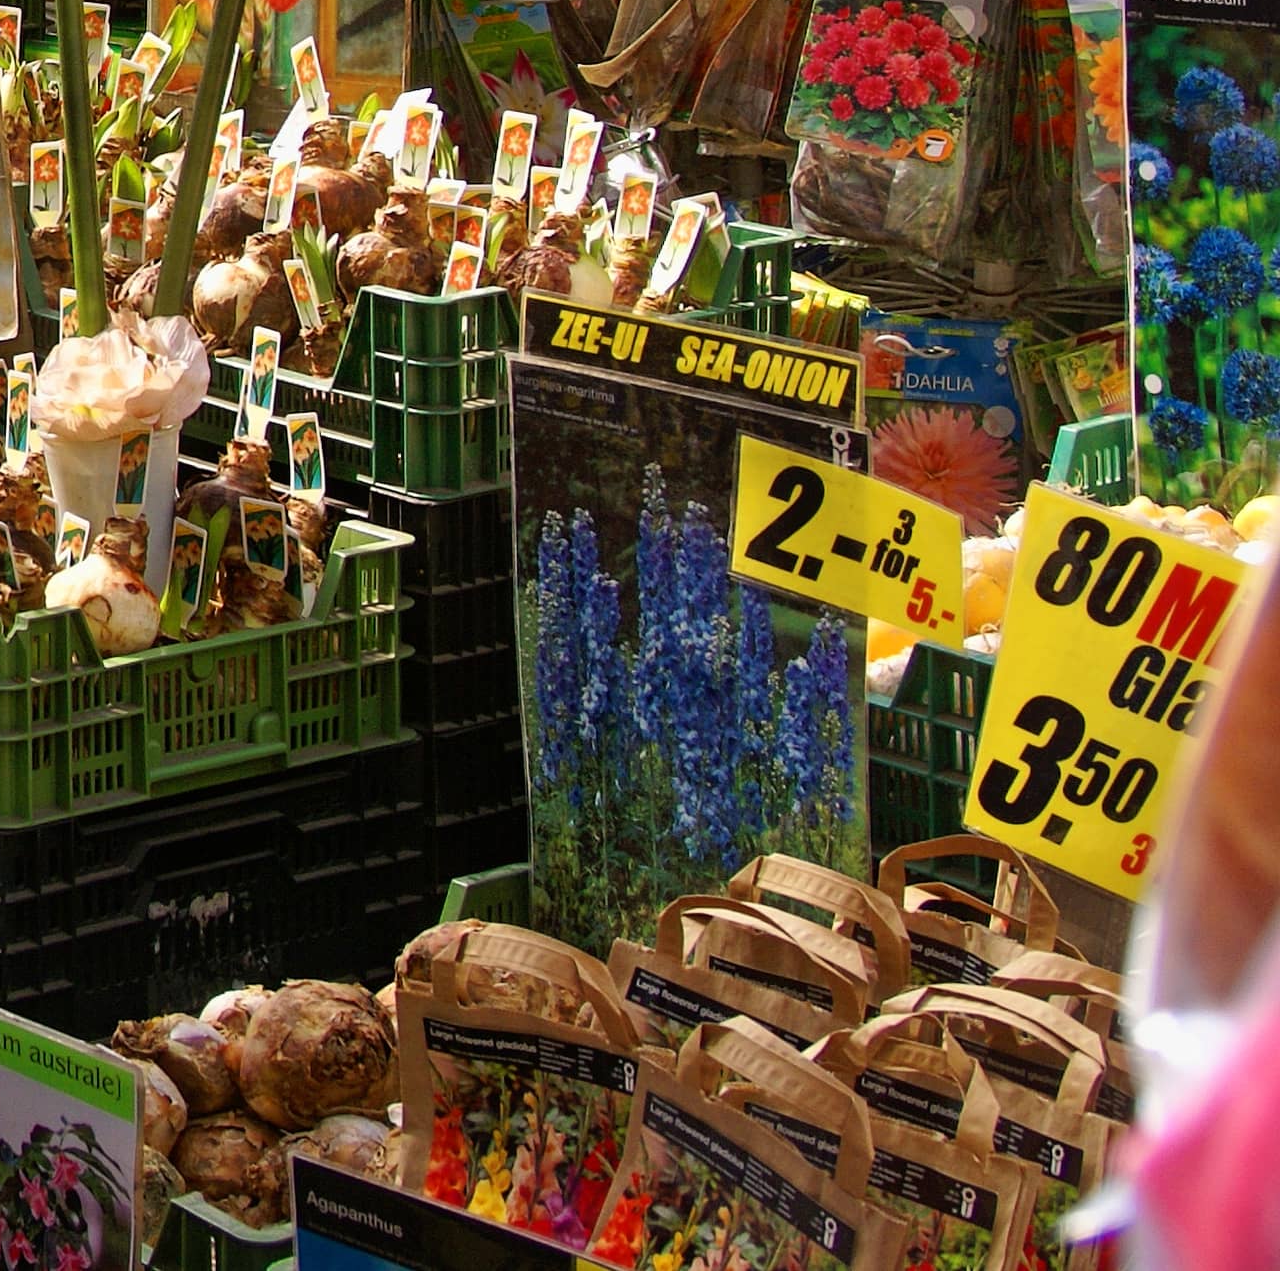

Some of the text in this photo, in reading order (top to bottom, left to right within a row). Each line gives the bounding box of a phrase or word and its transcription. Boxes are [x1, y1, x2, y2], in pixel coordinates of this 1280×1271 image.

[551, 309, 650, 365] ZEE-UI
[676, 335, 850, 409] SEA-ONION
[906, 372, 975, 393] DAHLIA
[744, 465, 913, 582] 2.- 3
[869, 543, 921, 586] for
[1034, 515, 1163, 628] 80
[906, 580, 956, 630] 5.-
[976, 695, 1160, 846] 3.50
[455, 1030, 538, 1055] flowered gladiolus
[29, 1039, 123, 1103] australe)
[890, 1085, 930, 1109] flowered
[710, 1139, 745, 1171] gladiolus
[304, 1190, 406, 1239] Agapanthus
